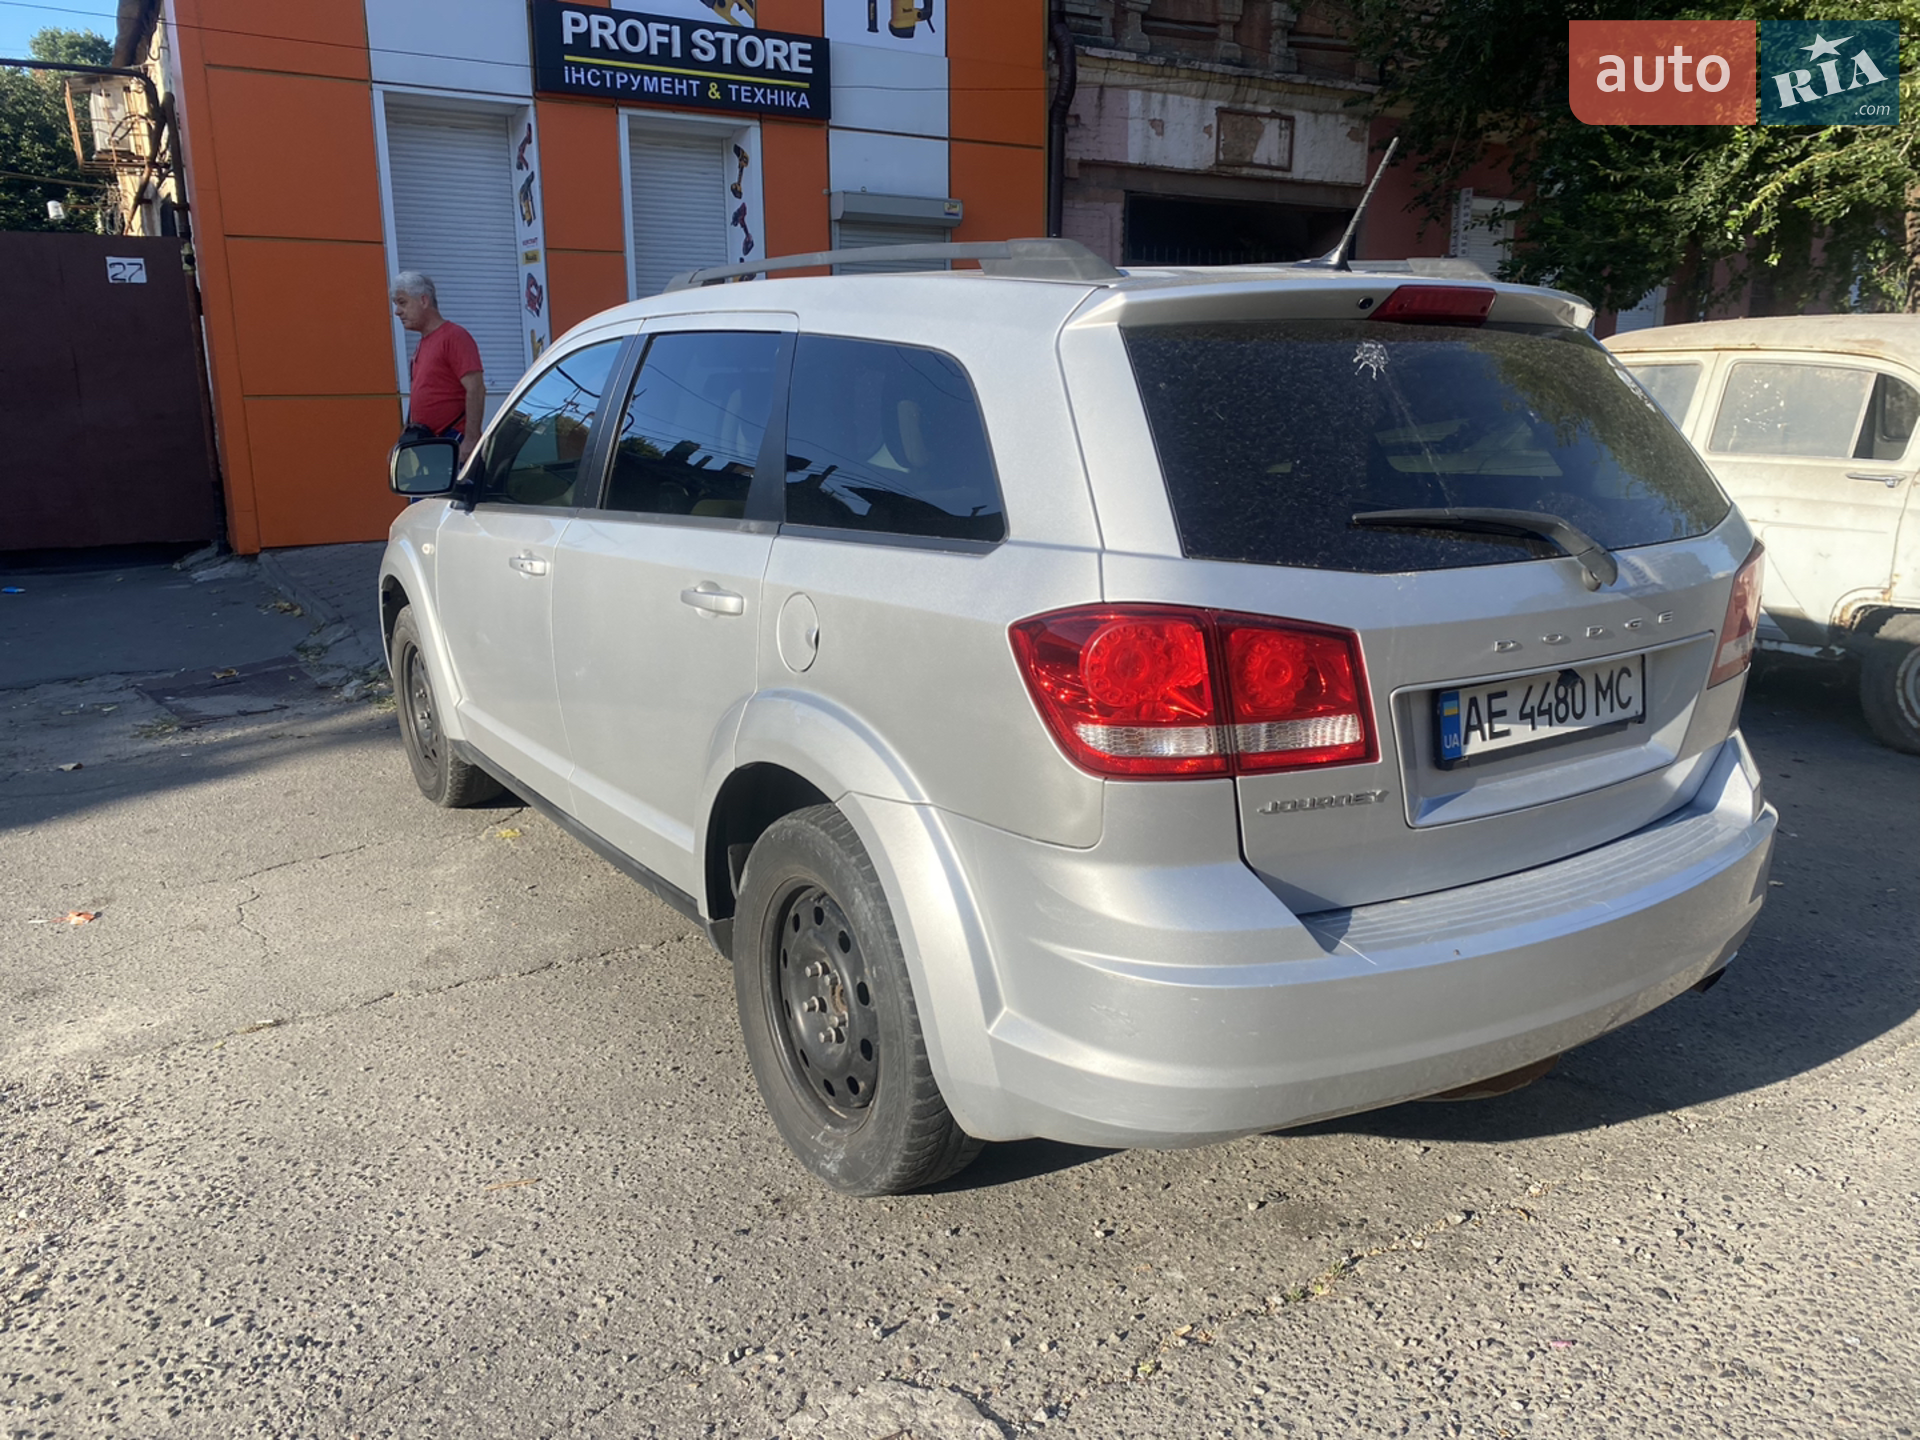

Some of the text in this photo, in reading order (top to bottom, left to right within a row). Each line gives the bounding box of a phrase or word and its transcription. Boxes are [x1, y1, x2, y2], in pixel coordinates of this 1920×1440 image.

[562, 10, 814, 74] PROFI STORE
[707, 82, 721, 100] &
[727, 84, 811, 109] ТЕХНІКА
[108, 262, 143, 282] 27
[1493, 610, 1674, 652] DODGE
[1463, 666, 1632, 745] AE 4480 MC
[1443, 733, 1460, 749] UA
[1256, 789, 1389, 815] JOURNEY
